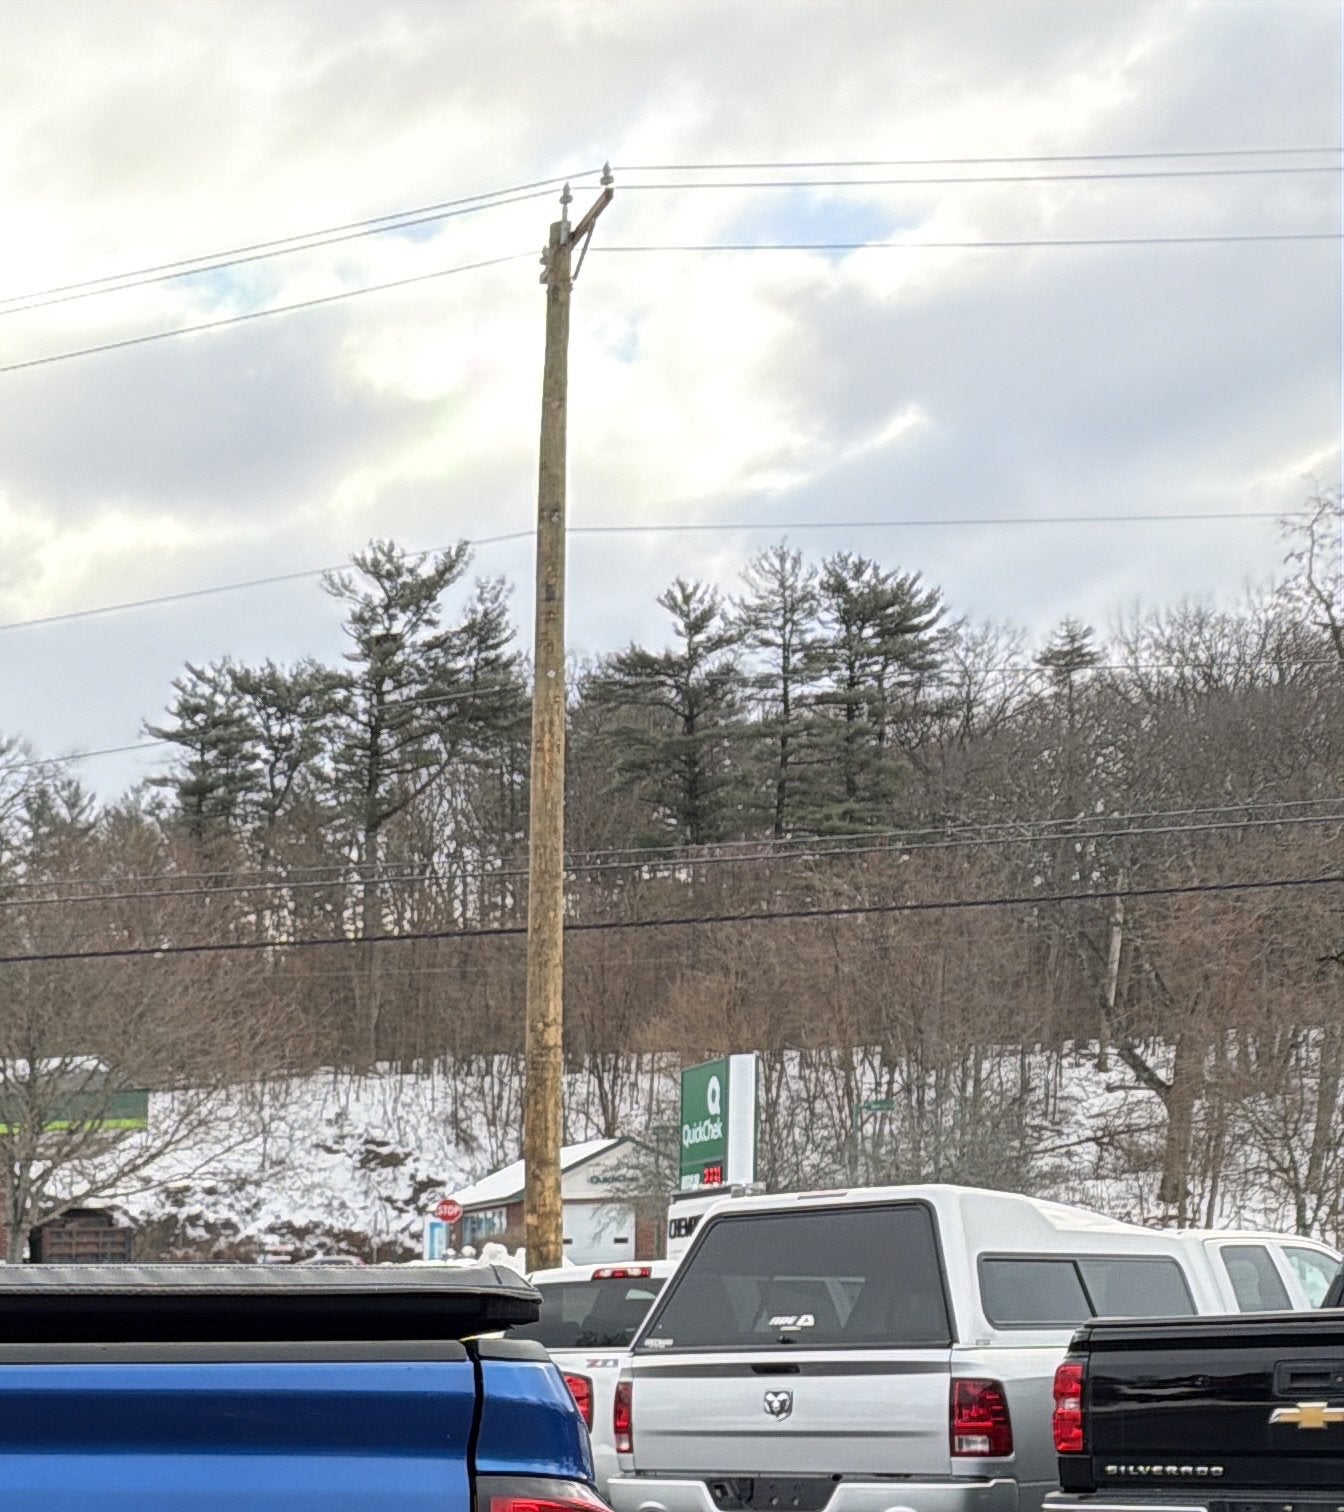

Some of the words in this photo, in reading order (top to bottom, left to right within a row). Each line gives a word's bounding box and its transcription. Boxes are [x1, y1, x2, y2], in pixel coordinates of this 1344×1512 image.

[707, 1075, 721, 1115] Q
[682, 1116, 723, 1149] QuickChek
[437, 1203, 461, 1217] STOP
[1104, 1464, 1224, 1477] SILVERADO
